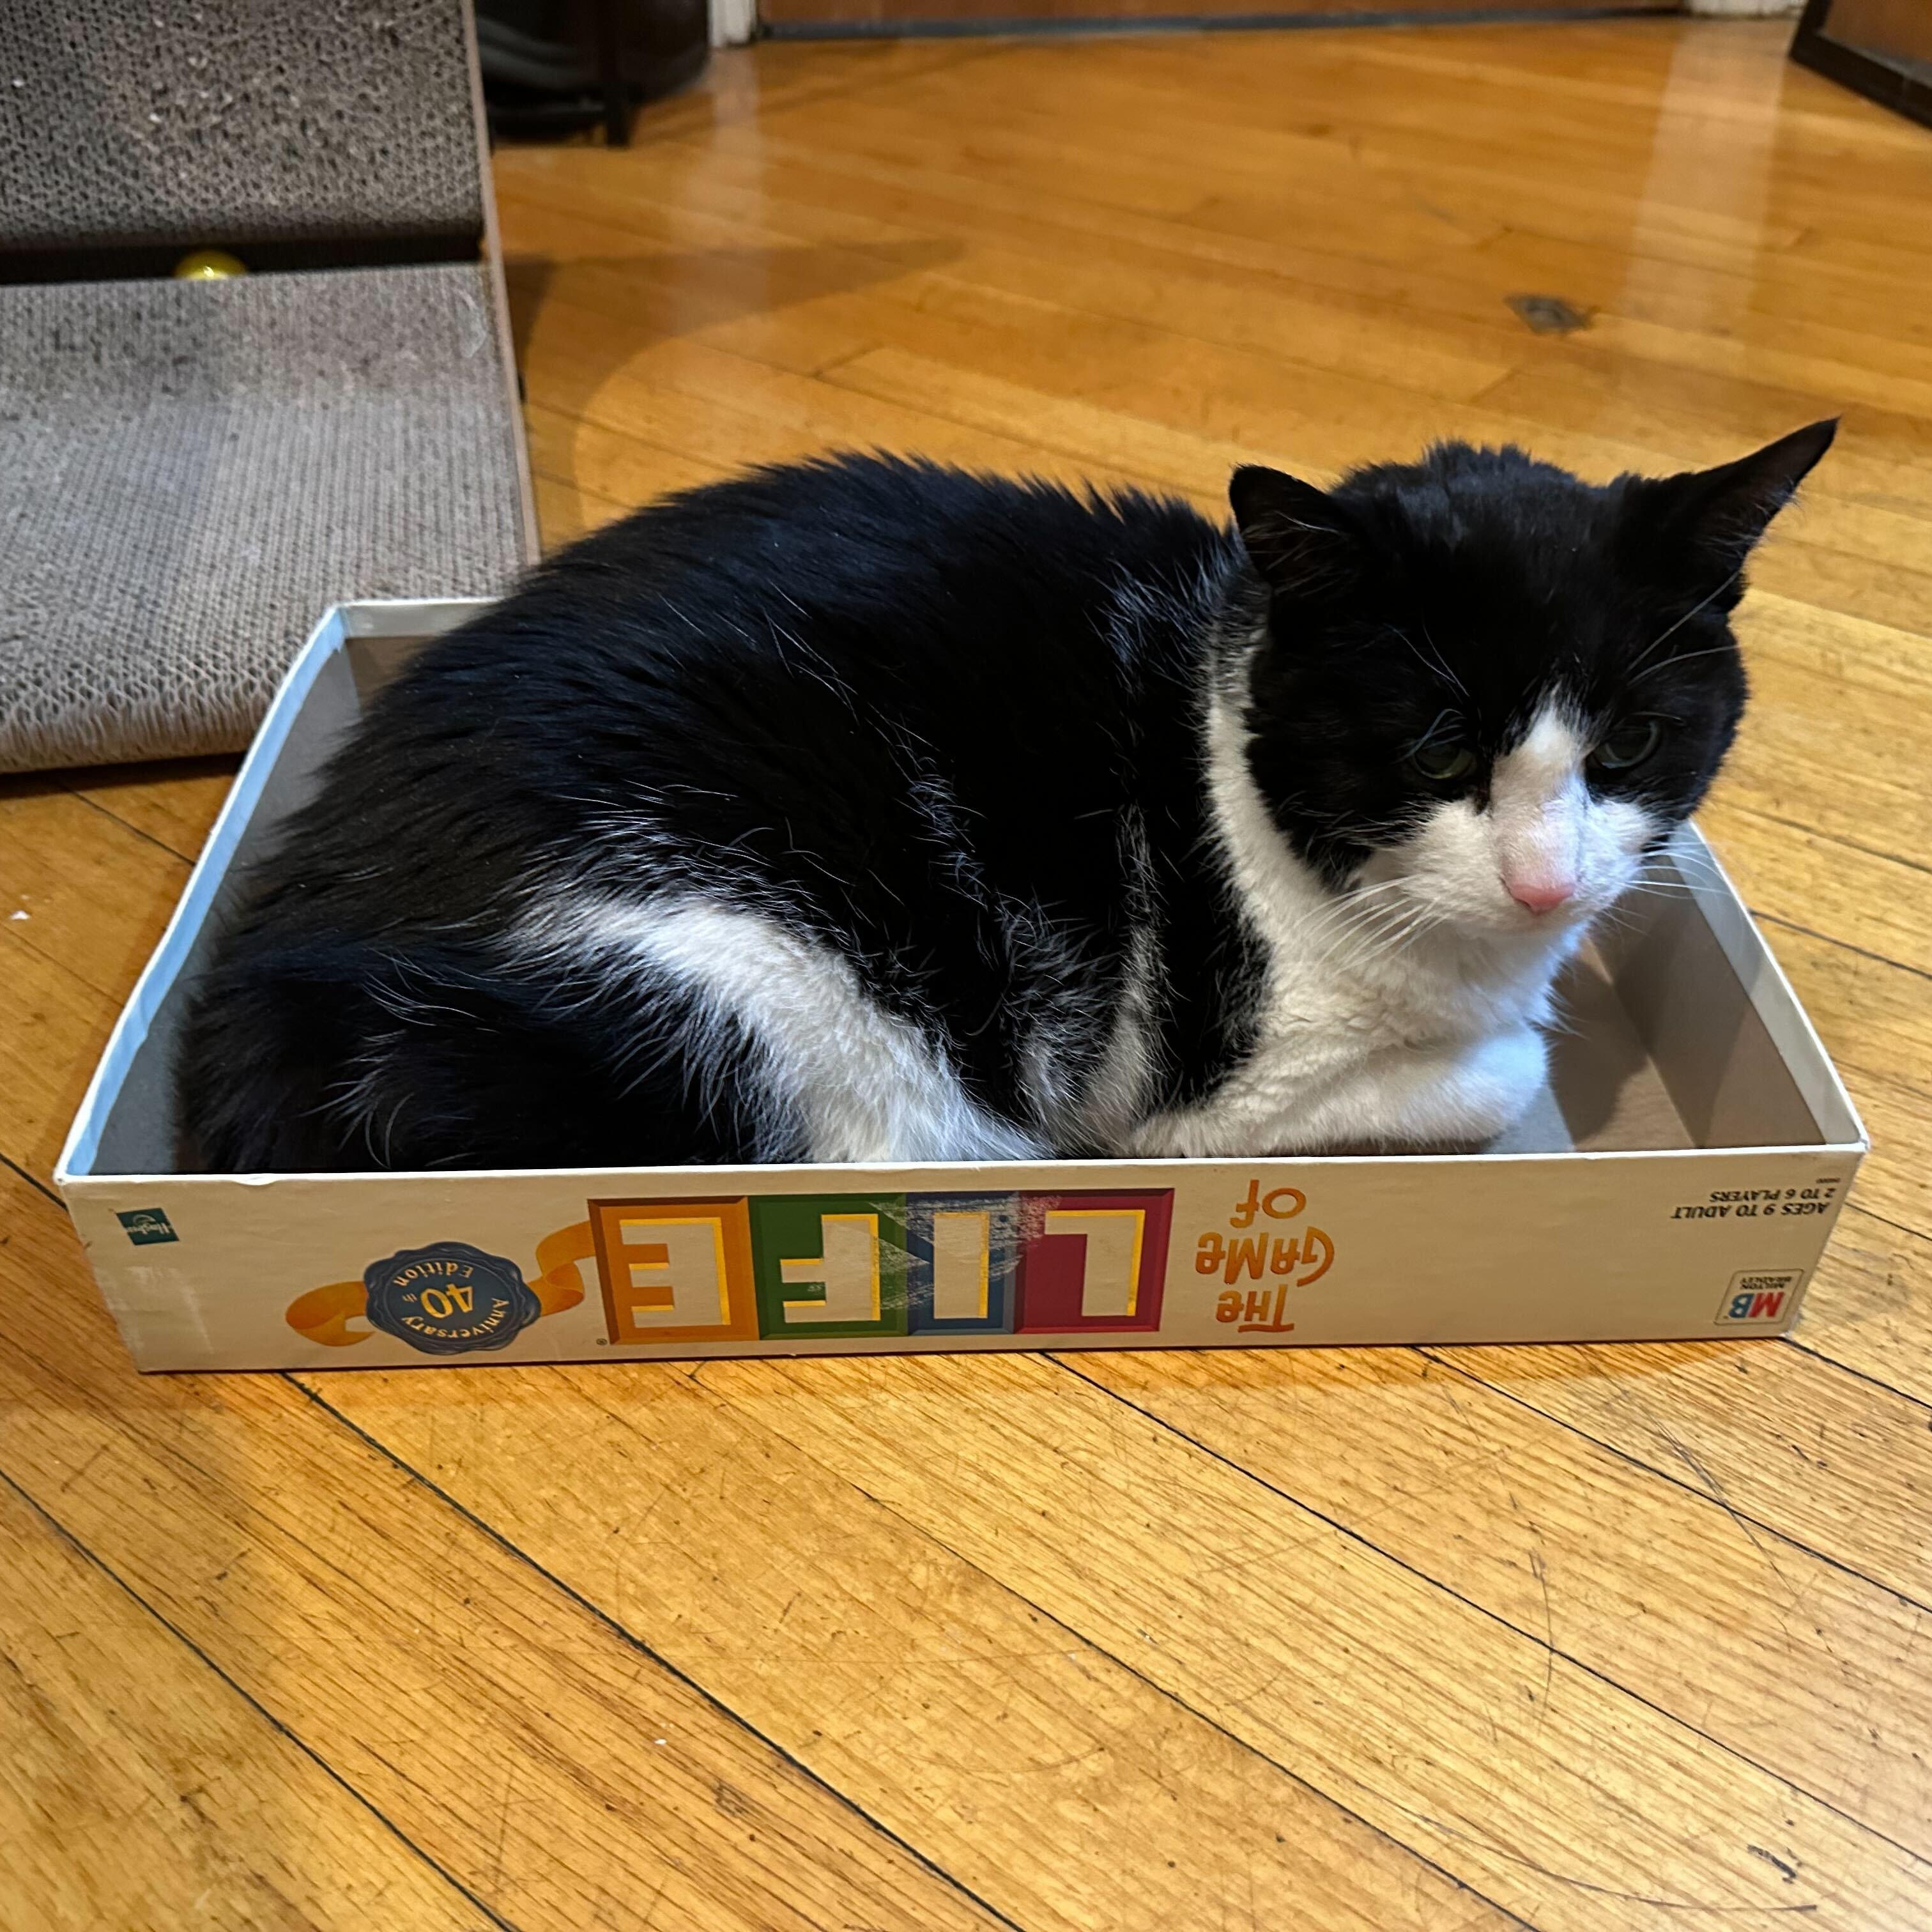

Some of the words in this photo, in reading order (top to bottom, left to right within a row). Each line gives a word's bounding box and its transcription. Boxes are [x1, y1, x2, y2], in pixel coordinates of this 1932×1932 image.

[1709, 1189, 1781, 1202] PLAYERS
[1784, 1188, 1796, 1199] 6
[1800, 1188, 1820, 1199] TO
[1824, 1188, 1837, 1199] 2
[1670, 1205, 1732, 1219] ADULT
[1735, 1204, 1758, 1216] TO
[1763, 1203, 1777, 1215] 9
[1781, 1202, 1830, 1215] AGES
[393, 1261, 475, 1287] Edition
[619, 1209, 1146, 1328] LIFE
[1728, 1291, 1785, 1319] MB
[401, 1297, 510, 1338] Anniversary
